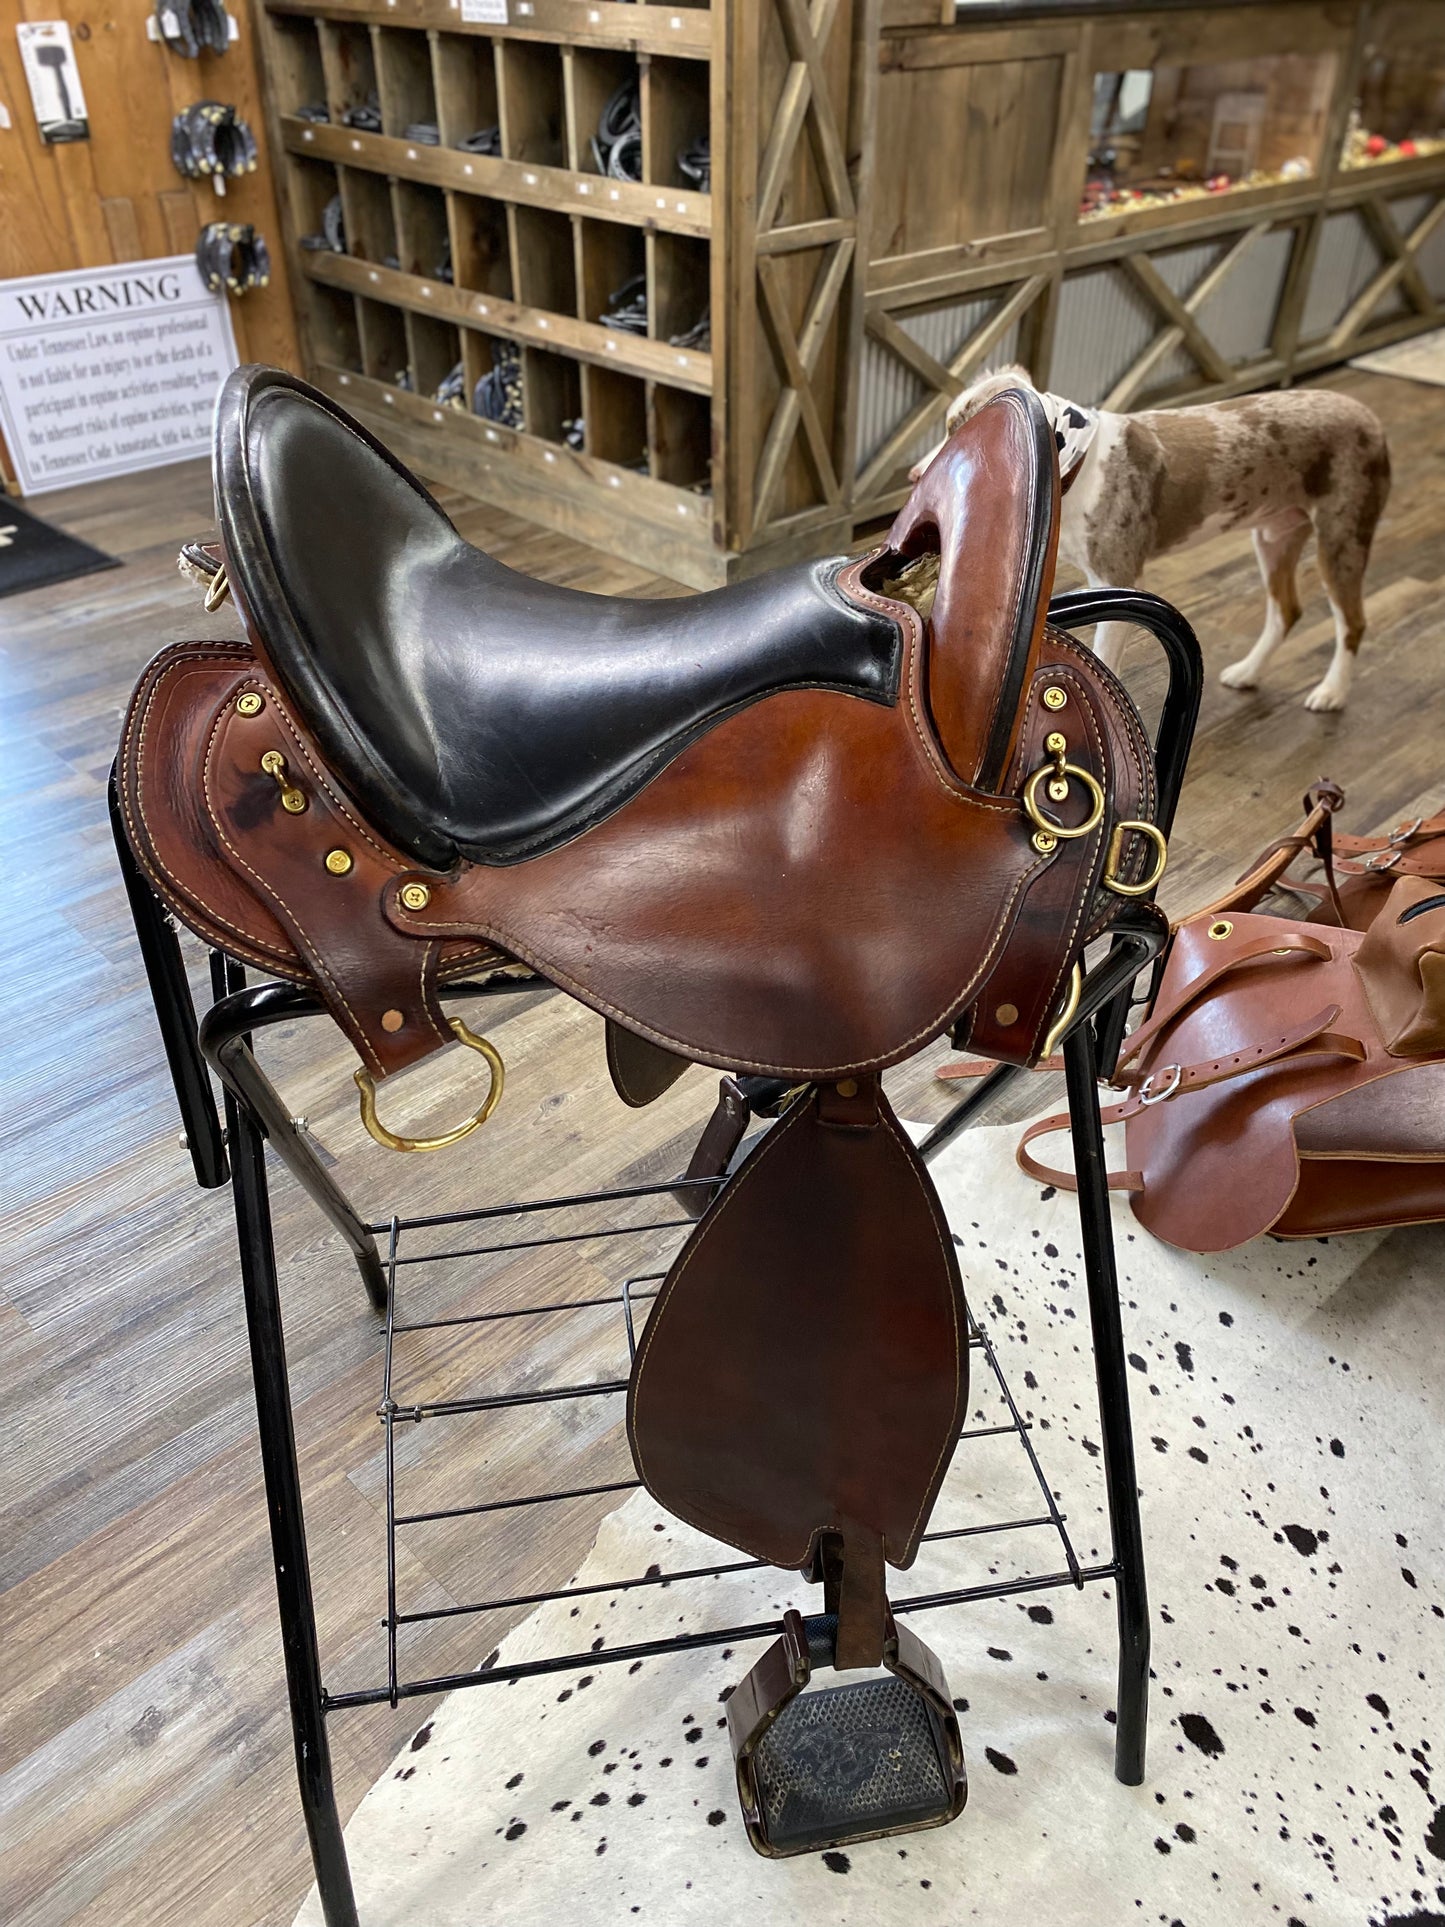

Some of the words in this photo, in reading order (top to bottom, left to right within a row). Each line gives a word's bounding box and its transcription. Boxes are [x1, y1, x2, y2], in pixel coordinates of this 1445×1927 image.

[15, 274, 180, 320] WARNING
[7, 344, 38, 361] Under
[40, 338, 87, 356] Tennessee
[126, 326, 154, 345] equine
[157, 312, 208, 341] professional
[29, 373, 46, 387] not
[46, 367, 72, 385] liable
[73, 362, 88, 380] for
[103, 356, 131, 378] injury
[155, 348, 169, 365] the
[171, 343, 195, 362] death
[24, 396, 76, 423] participant
[89, 388, 119, 410] equine
[121, 379, 159, 400] activities
[160, 371, 198, 390] resulting
[28, 429, 45, 446] the
[46, 422, 84, 442] inherent
[85, 416, 109, 433] risks
[120, 411, 149, 431] equine
[41, 454, 88, 473] Tennessee
[88, 444, 112, 462] Code
